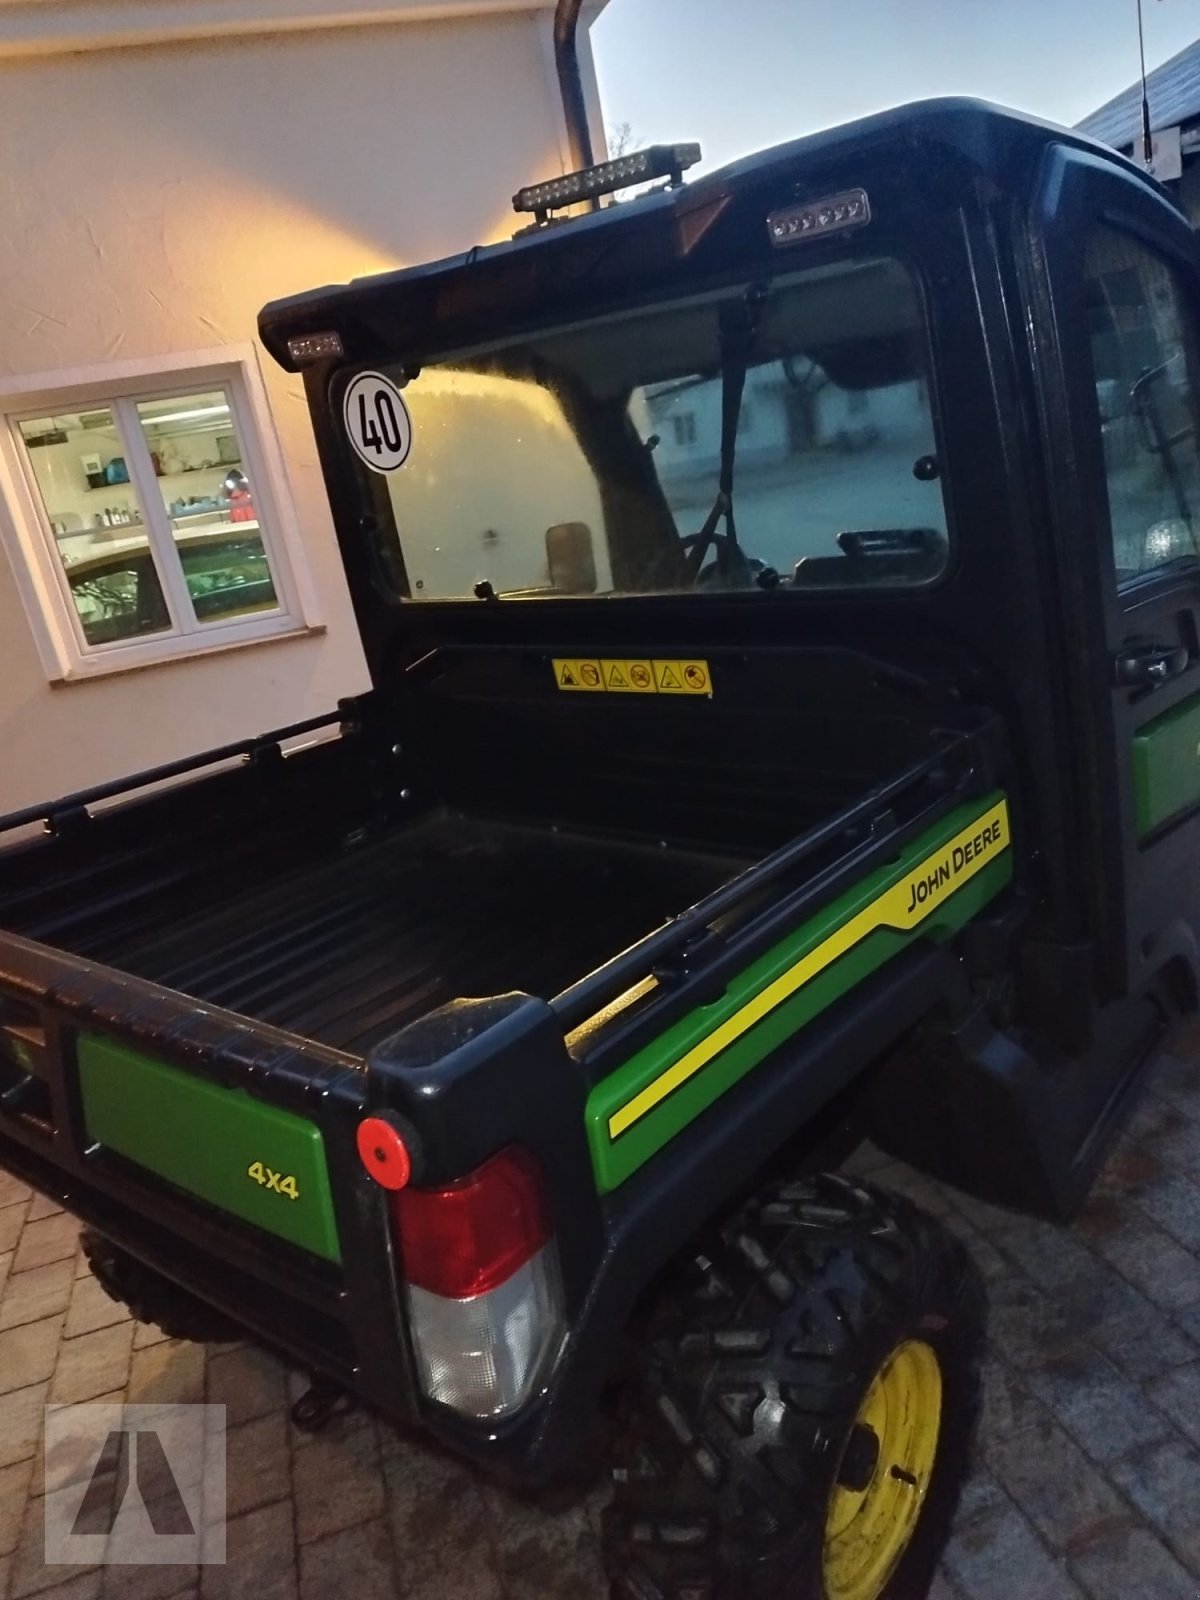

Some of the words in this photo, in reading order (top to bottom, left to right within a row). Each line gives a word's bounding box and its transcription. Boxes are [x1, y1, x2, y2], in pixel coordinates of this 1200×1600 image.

[358, 389, 402, 455] 40
[907, 860, 950, 913] JOHN
[952, 819, 1001, 874] DEERE
